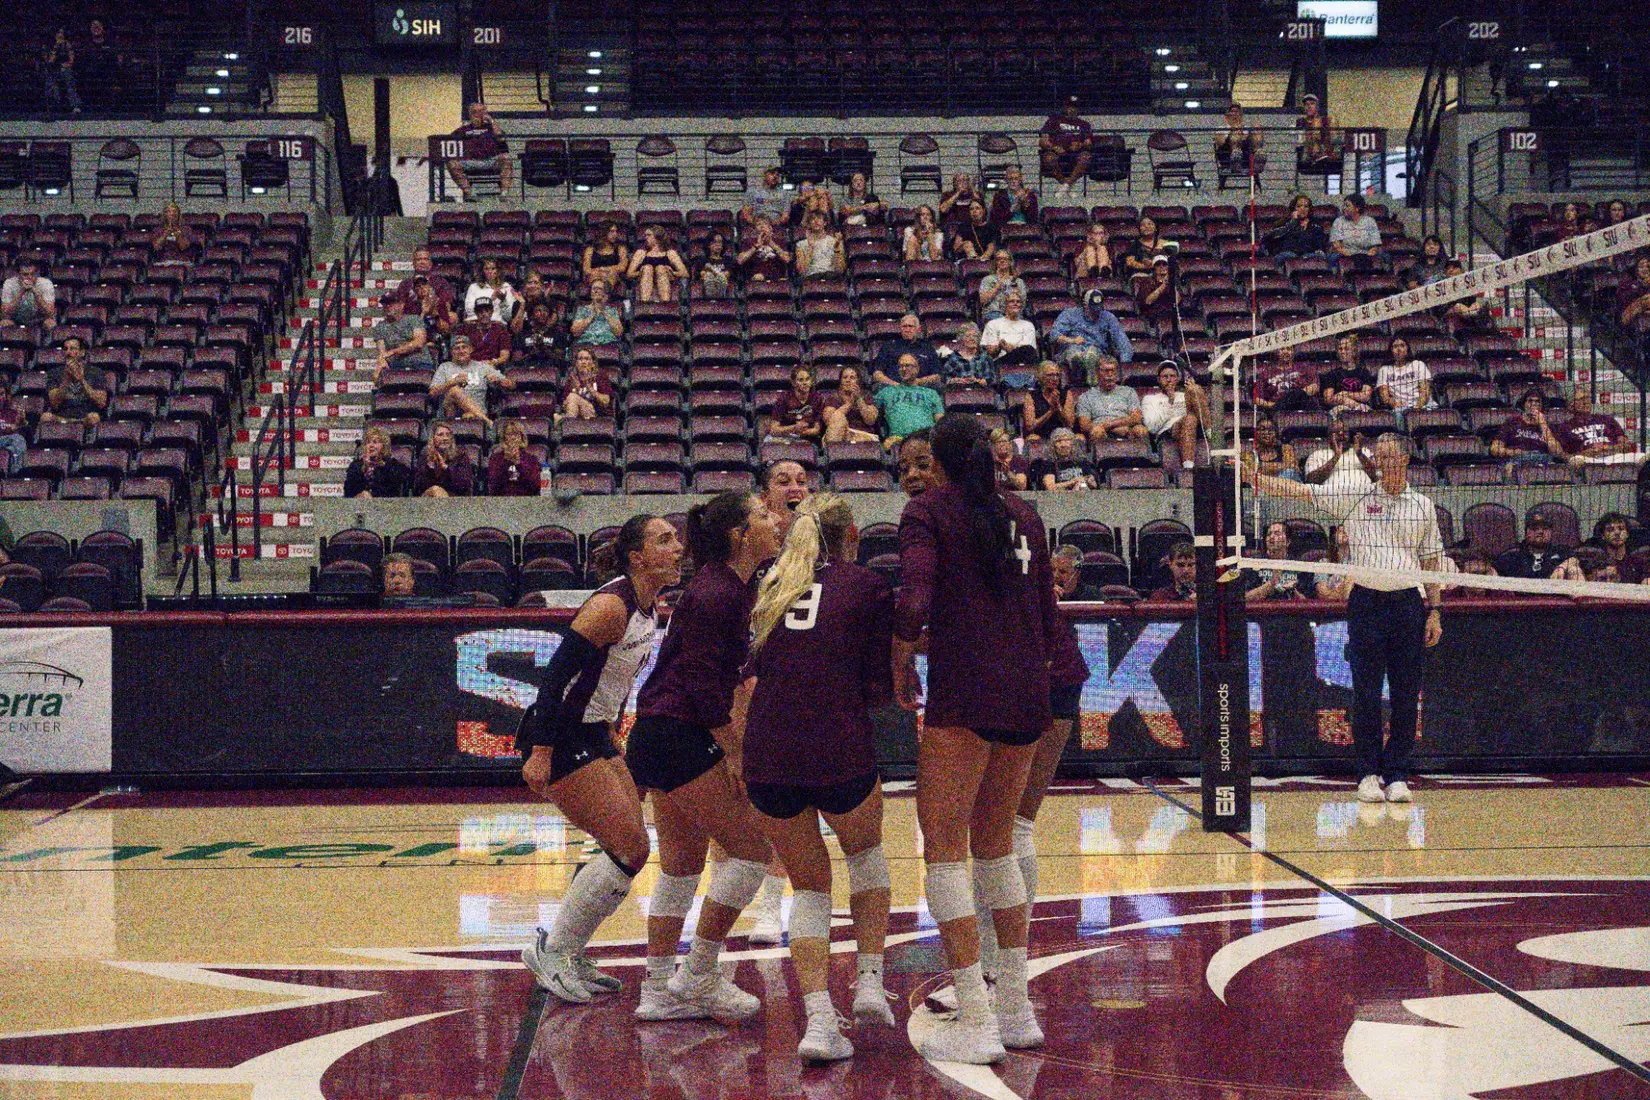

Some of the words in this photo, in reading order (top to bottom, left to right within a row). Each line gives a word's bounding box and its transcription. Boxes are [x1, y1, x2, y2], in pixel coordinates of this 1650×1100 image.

[285, 27, 312, 44] 216
[411, 20, 441, 36] SIH
[473, 27, 501, 44] 201
[1288, 22, 1314, 39] 201
[1469, 22, 1499, 39] 202
[279, 141, 302, 158] 116
[440, 140, 464, 158] 101
[1353, 132, 1377, 151] 101
[1510, 132, 1537, 150] 102
[312, 487, 343, 496] TOYOTA
[784, 583, 823, 630] 9
[1217, 683, 1231, 722] sports
[1218, 724, 1232, 772] imports
